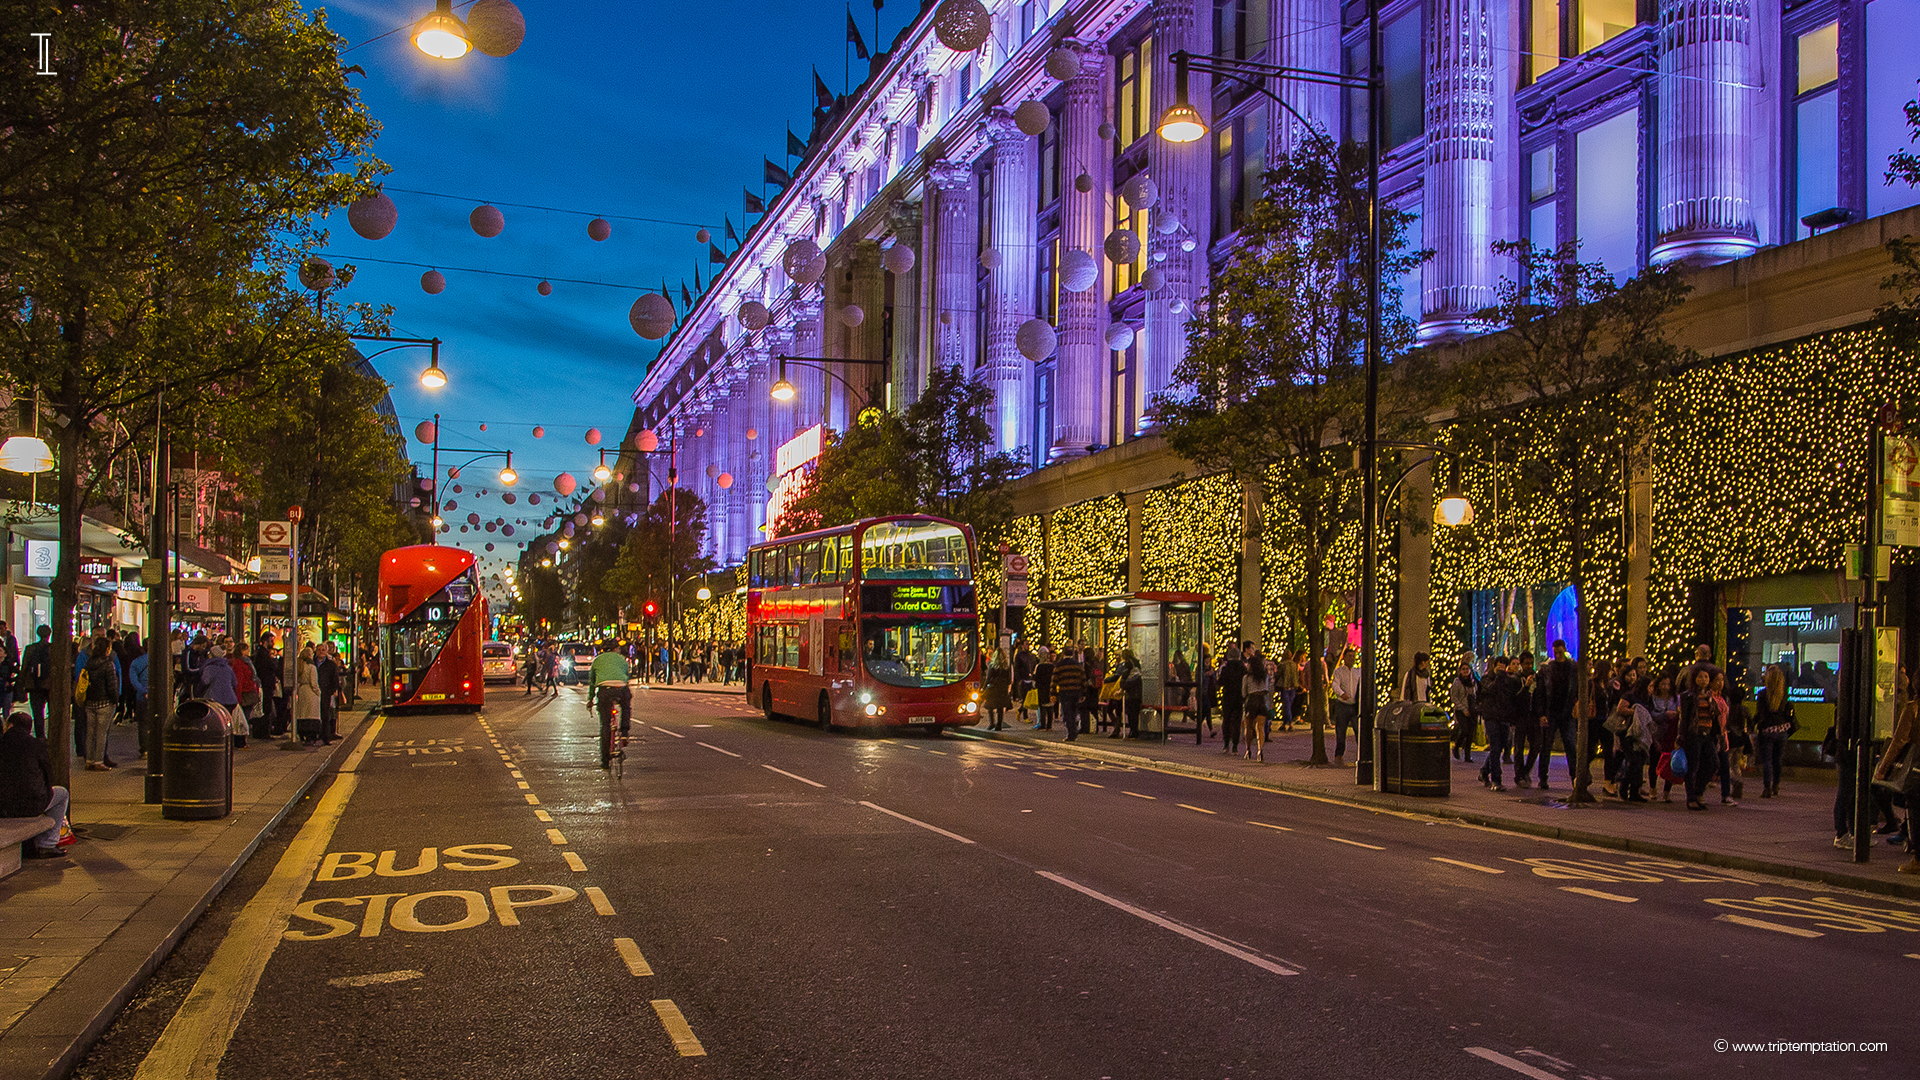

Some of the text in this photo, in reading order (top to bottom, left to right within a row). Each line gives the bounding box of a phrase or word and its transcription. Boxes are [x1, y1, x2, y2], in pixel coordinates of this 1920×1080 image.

[35, 547, 51, 568] 3
[928, 586, 941, 599] 137
[894, 601, 943, 611] Oxford Circus
[428, 607, 441, 621] 10
[1765, 611, 1812, 622] EVERYMAN
[316, 843, 520, 881] BUS
[283, 884, 579, 941] STOP
